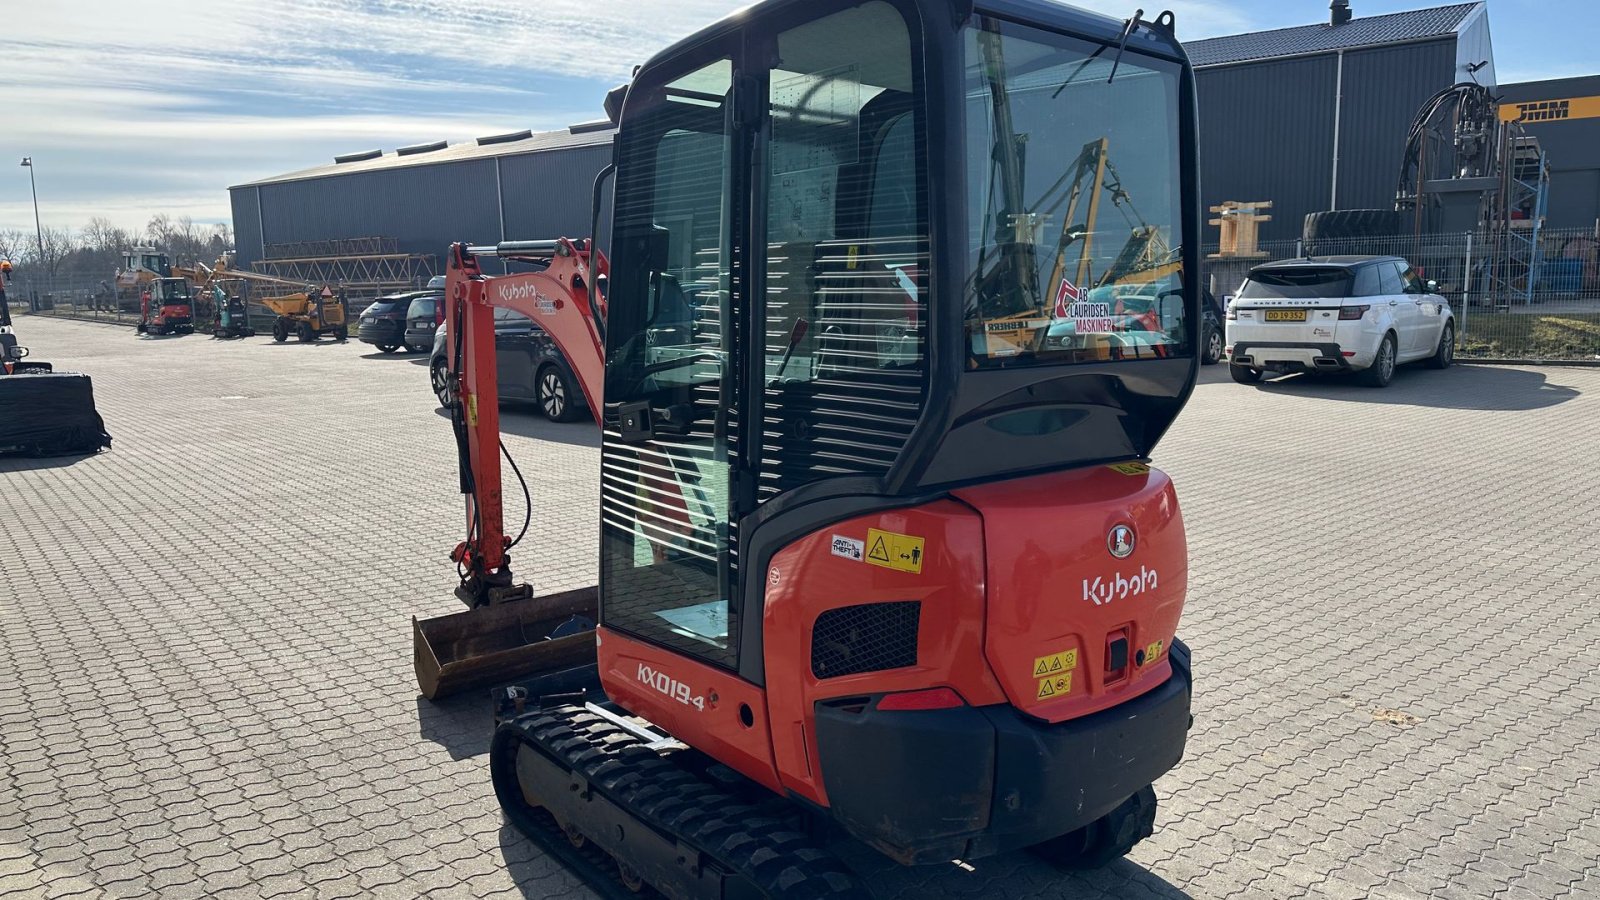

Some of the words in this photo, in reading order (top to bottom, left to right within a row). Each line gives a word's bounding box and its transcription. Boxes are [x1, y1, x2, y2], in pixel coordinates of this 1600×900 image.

[499, 281, 536, 300] Kubota
[1078, 288, 1088, 302] AB
[1070, 303, 1109, 318] LAURIDSEN
[1075, 319, 1113, 333] MASKINER
[832, 544, 852, 555] THEFT
[833, 539, 852, 548] ANTI-
[1082, 565, 1158, 606] Kubota
[637, 663, 705, 712] KX019-4
